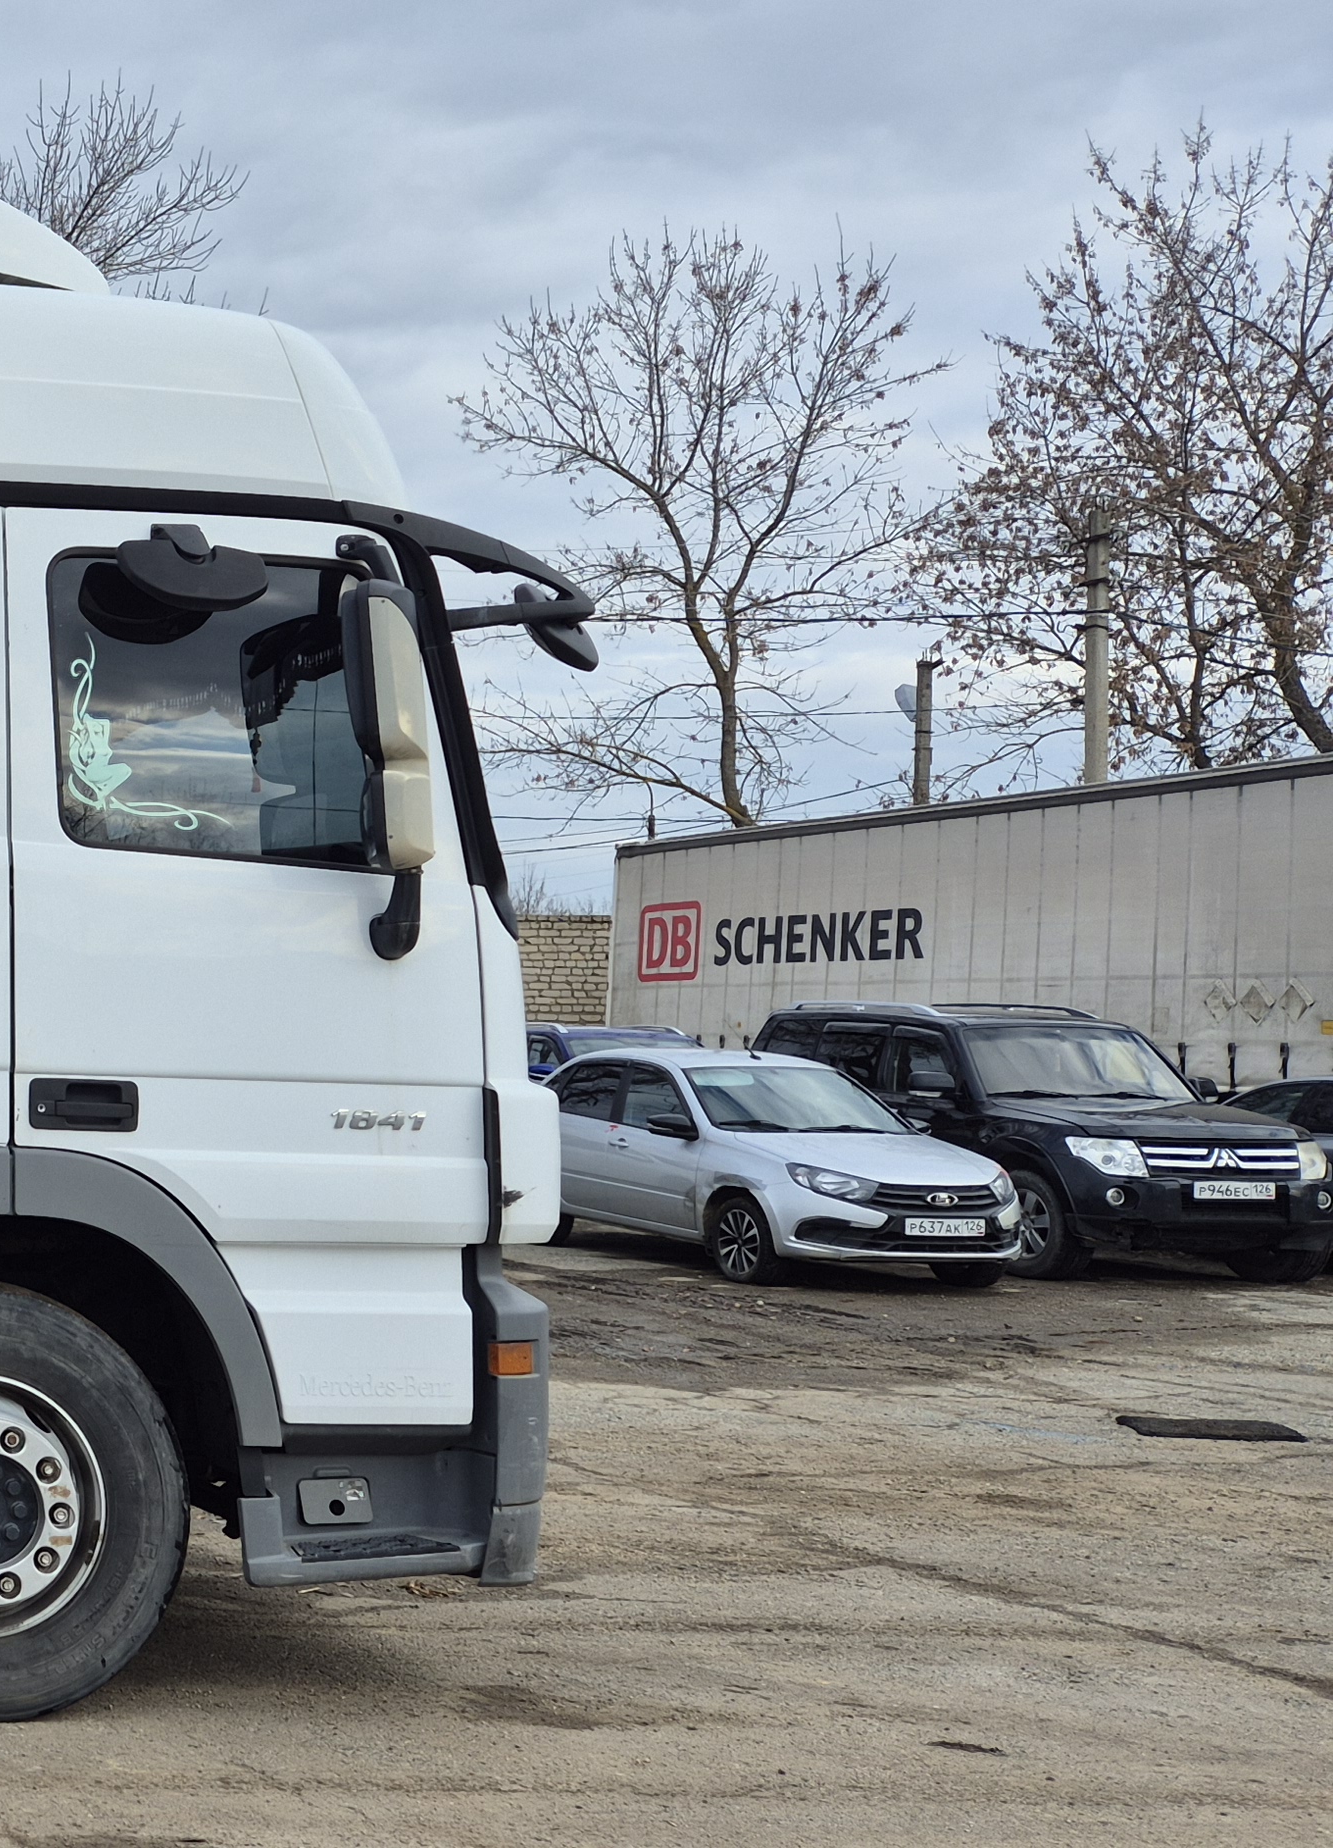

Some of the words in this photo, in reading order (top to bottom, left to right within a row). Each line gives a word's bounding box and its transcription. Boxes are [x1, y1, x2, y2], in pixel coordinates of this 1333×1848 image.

[645, 915, 692, 969] DB
[714, 908, 924, 966] SCHENKER
[331, 1109, 427, 1131] 1841
[1199, 1184, 1250, 1197] Р946ЕС
[1253, 1184, 1271, 1193] 126
[910, 1221, 961, 1234] Р637АК
[964, 1221, 983, 1231] 126
